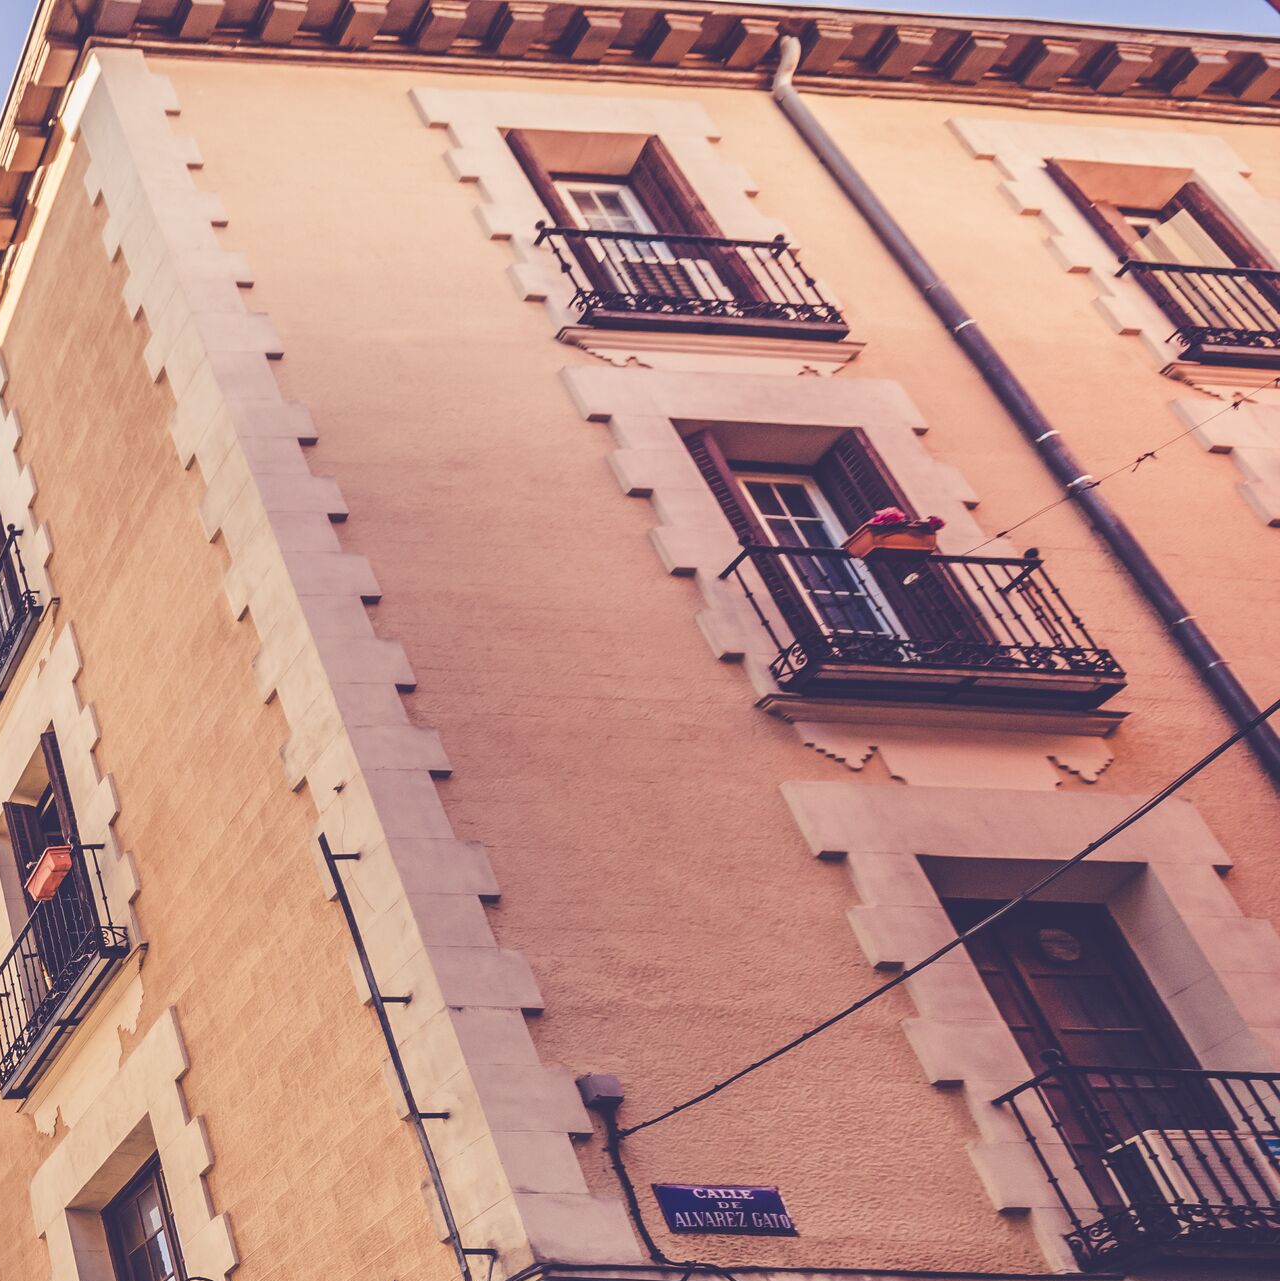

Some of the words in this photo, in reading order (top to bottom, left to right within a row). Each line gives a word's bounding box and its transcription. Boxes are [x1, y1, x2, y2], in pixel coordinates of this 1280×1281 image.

[692, 1189, 755, 1200] CALLE
[717, 1201, 743, 1209] DE
[675, 1211, 748, 1228] ALVAREZ
[751, 1212, 791, 1229] GATO
